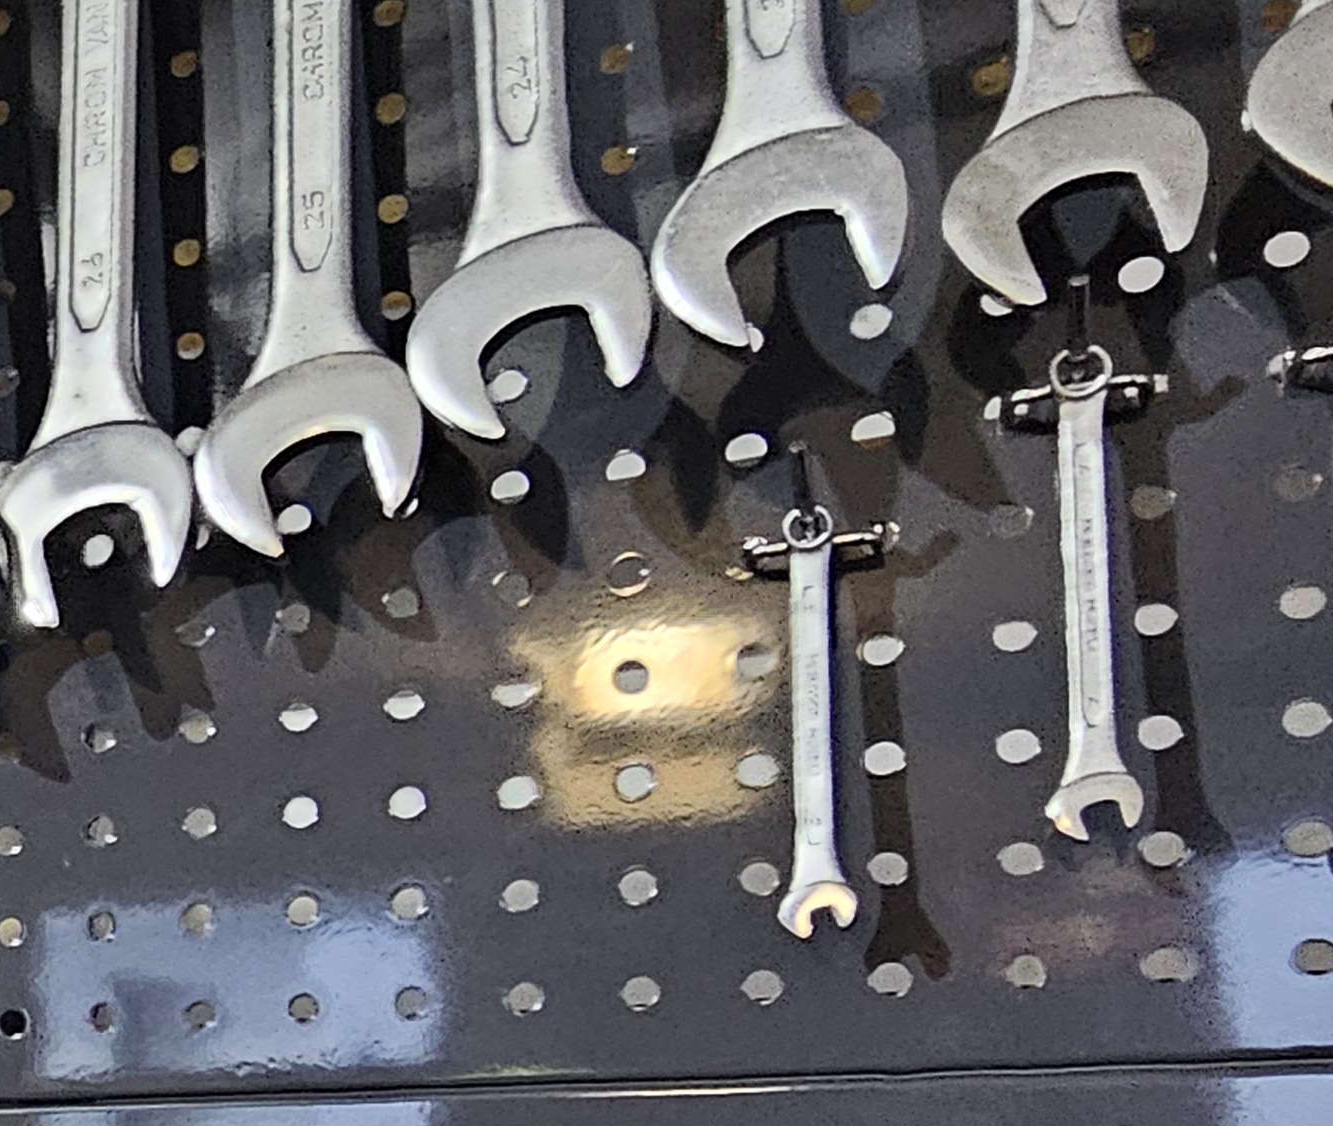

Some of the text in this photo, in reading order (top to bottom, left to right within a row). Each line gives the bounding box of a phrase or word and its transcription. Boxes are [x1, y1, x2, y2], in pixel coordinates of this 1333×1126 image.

[505, 56, 536, 101] 24
[82, 67, 109, 169] CHROM
[302, 189, 326, 231] 25
[82, 251, 106, 288] 26
